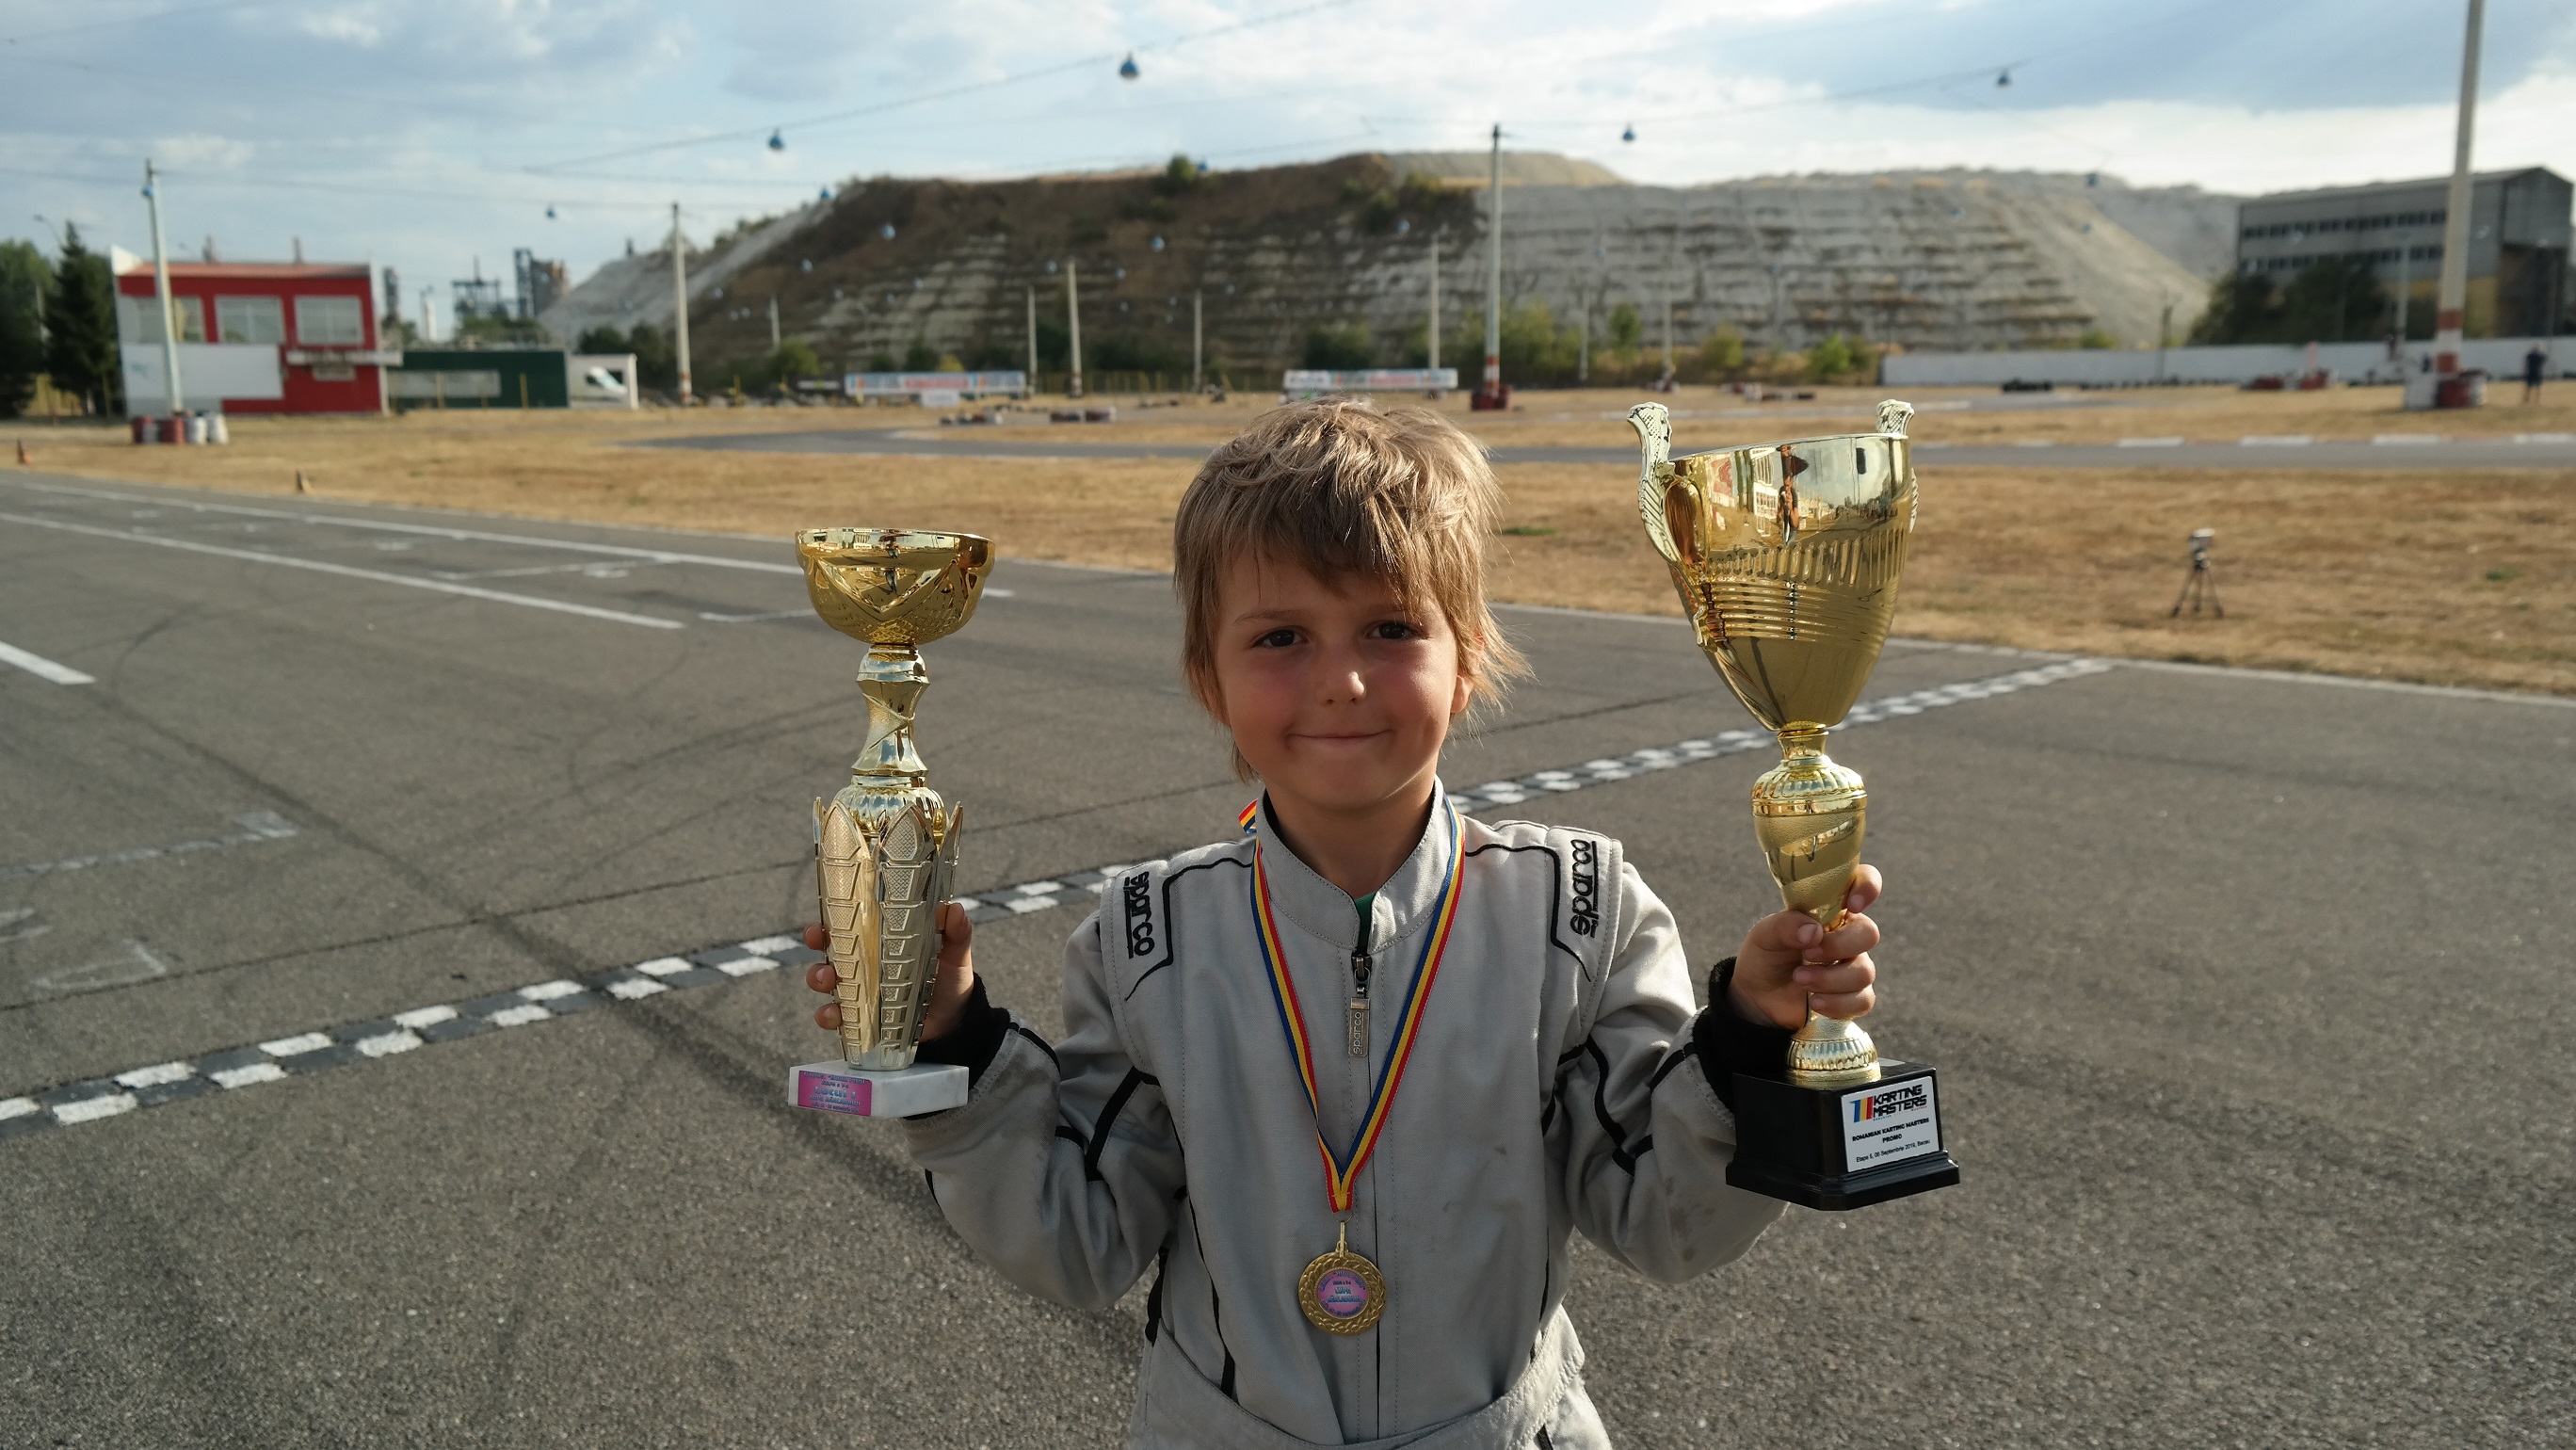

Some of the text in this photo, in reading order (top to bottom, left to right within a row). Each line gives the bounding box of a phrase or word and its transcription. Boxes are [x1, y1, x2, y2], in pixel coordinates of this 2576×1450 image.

[1570, 839, 1599, 937] sparco
[1123, 871, 1155, 958] sparco
[1353, 1012, 1364, 1055] sparco
[1873, 1095, 1927, 1118] MASTERS
[1874, 1085, 1923, 1106] KARTING
[1852, 1130, 1881, 1142] ROMANIAN
[1882, 1123, 1906, 1135] KARTING
[1906, 1118, 1930, 1128] MASTERS
[1882, 1134, 1903, 1144] PROMO
[1880, 1146, 1905, 1156] Septembrie
